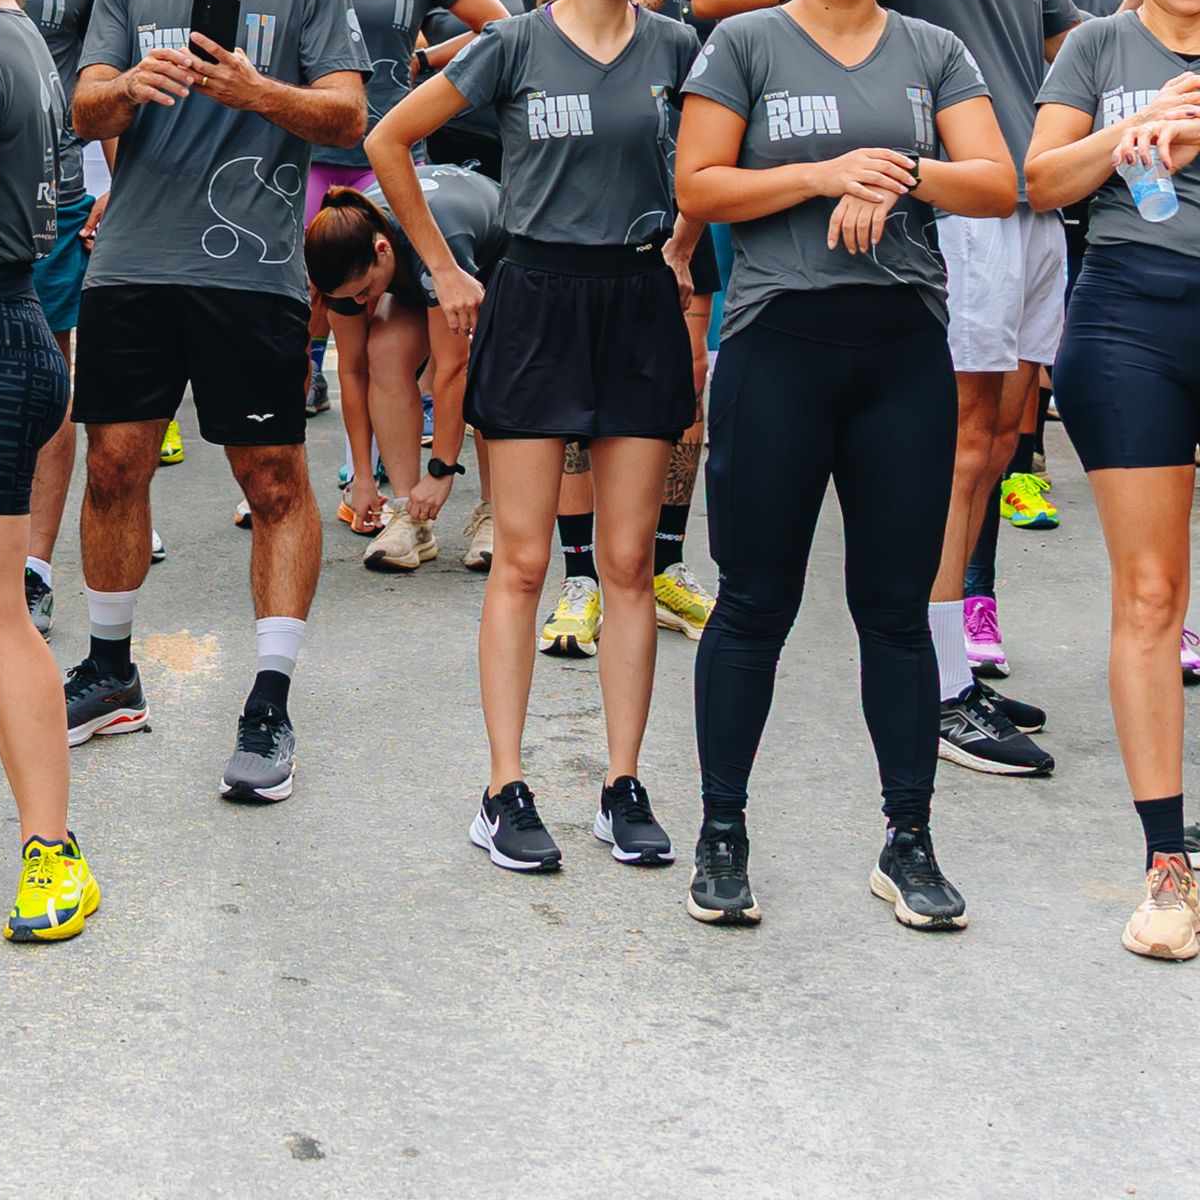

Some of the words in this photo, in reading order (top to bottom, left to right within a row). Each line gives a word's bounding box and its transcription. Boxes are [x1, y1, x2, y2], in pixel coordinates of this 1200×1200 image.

[246, 13, 276, 67] 11
[527, 94, 594, 141] RUN
[764, 90, 789, 101] smart
[766, 95, 842, 142] RUN
[906, 87, 934, 145] 11
